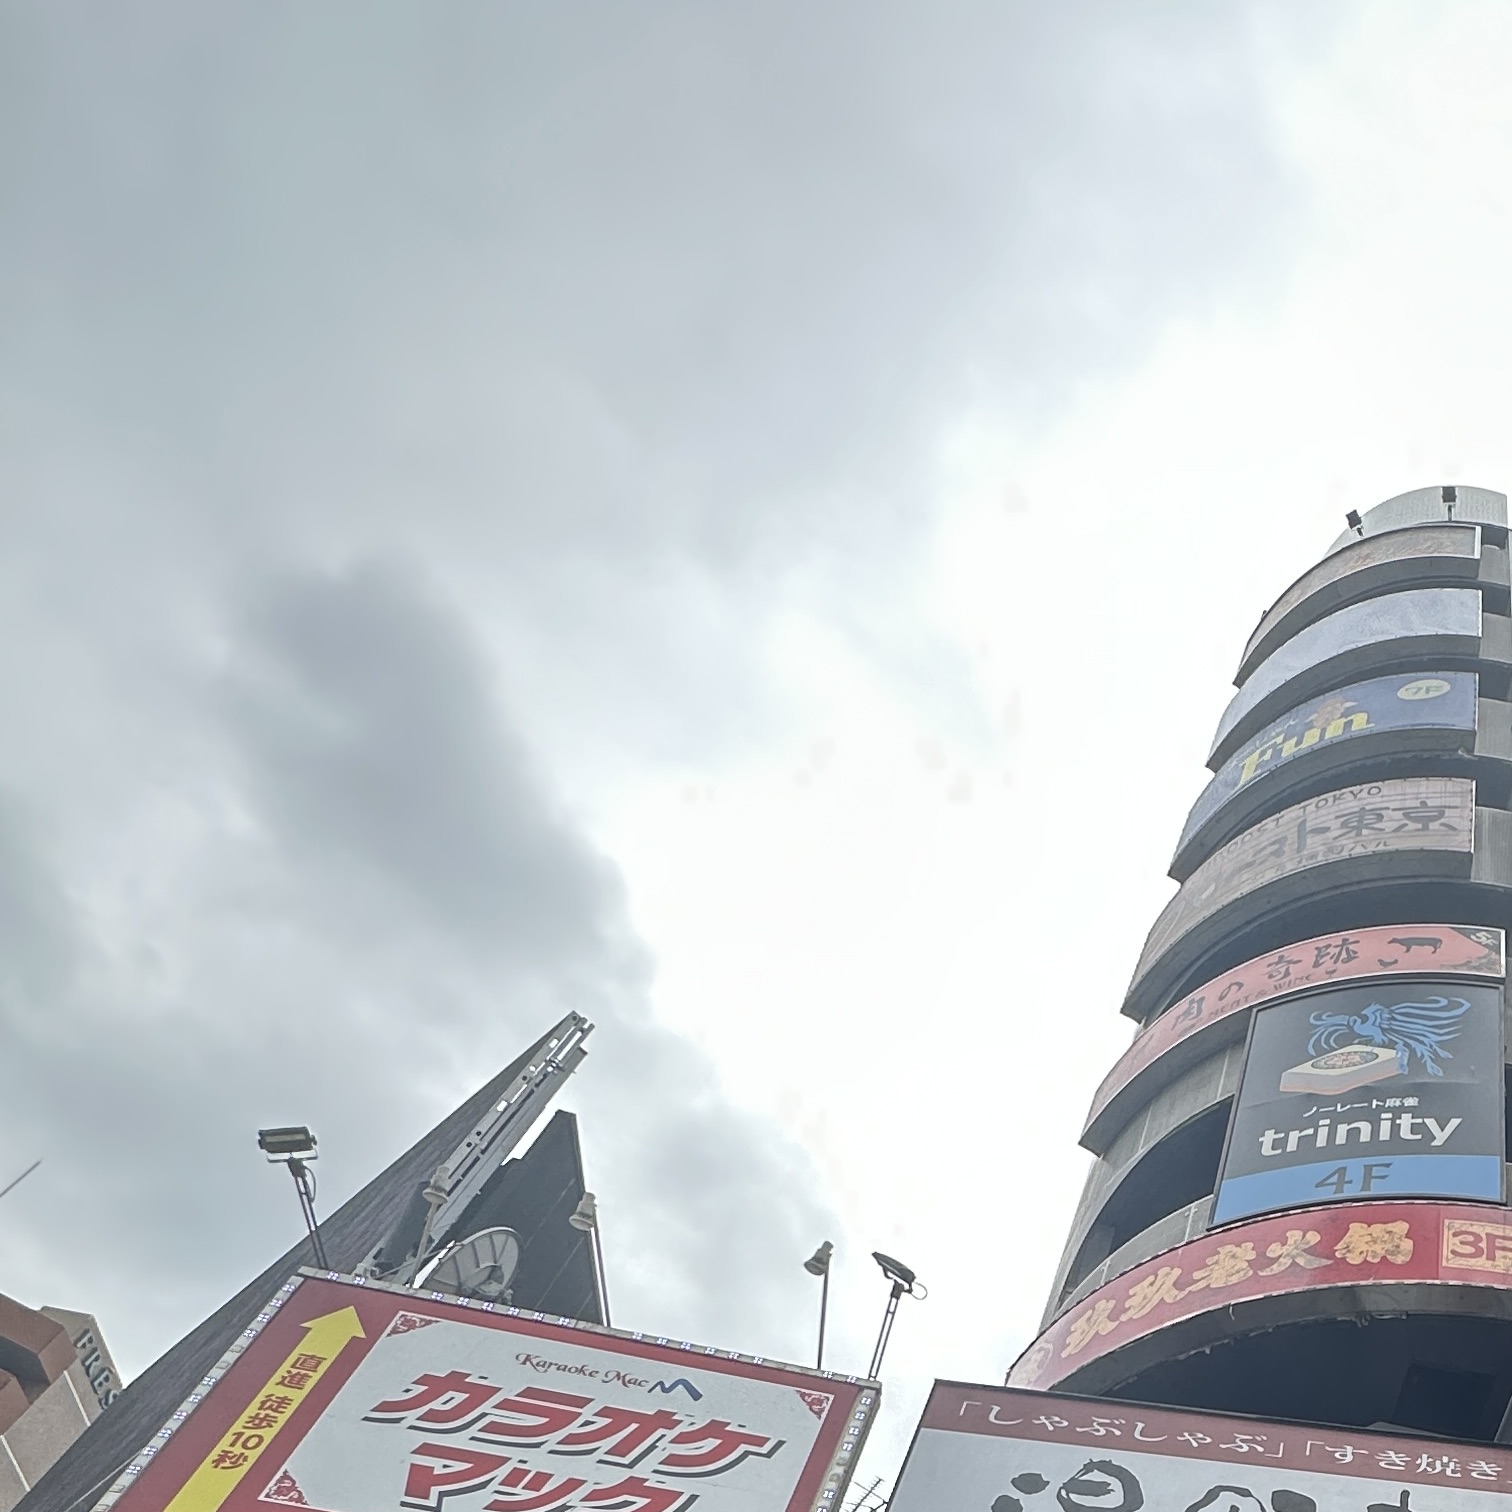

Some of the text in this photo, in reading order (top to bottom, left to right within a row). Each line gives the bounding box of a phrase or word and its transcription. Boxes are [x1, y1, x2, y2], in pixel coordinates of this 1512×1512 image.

[1236, 711, 1375, 788] Fun
[1301, 786, 1383, 813] TOKYO
[1259, 1112, 1463, 1159] trinity
[1315, 1162, 1394, 1194] 4F
[515, 1352, 651, 1390] Karaoke Mac
[211, 1351, 327, 1471] 直進 徒歩10秒
[362, 1369, 786, 1479] カラオケ
